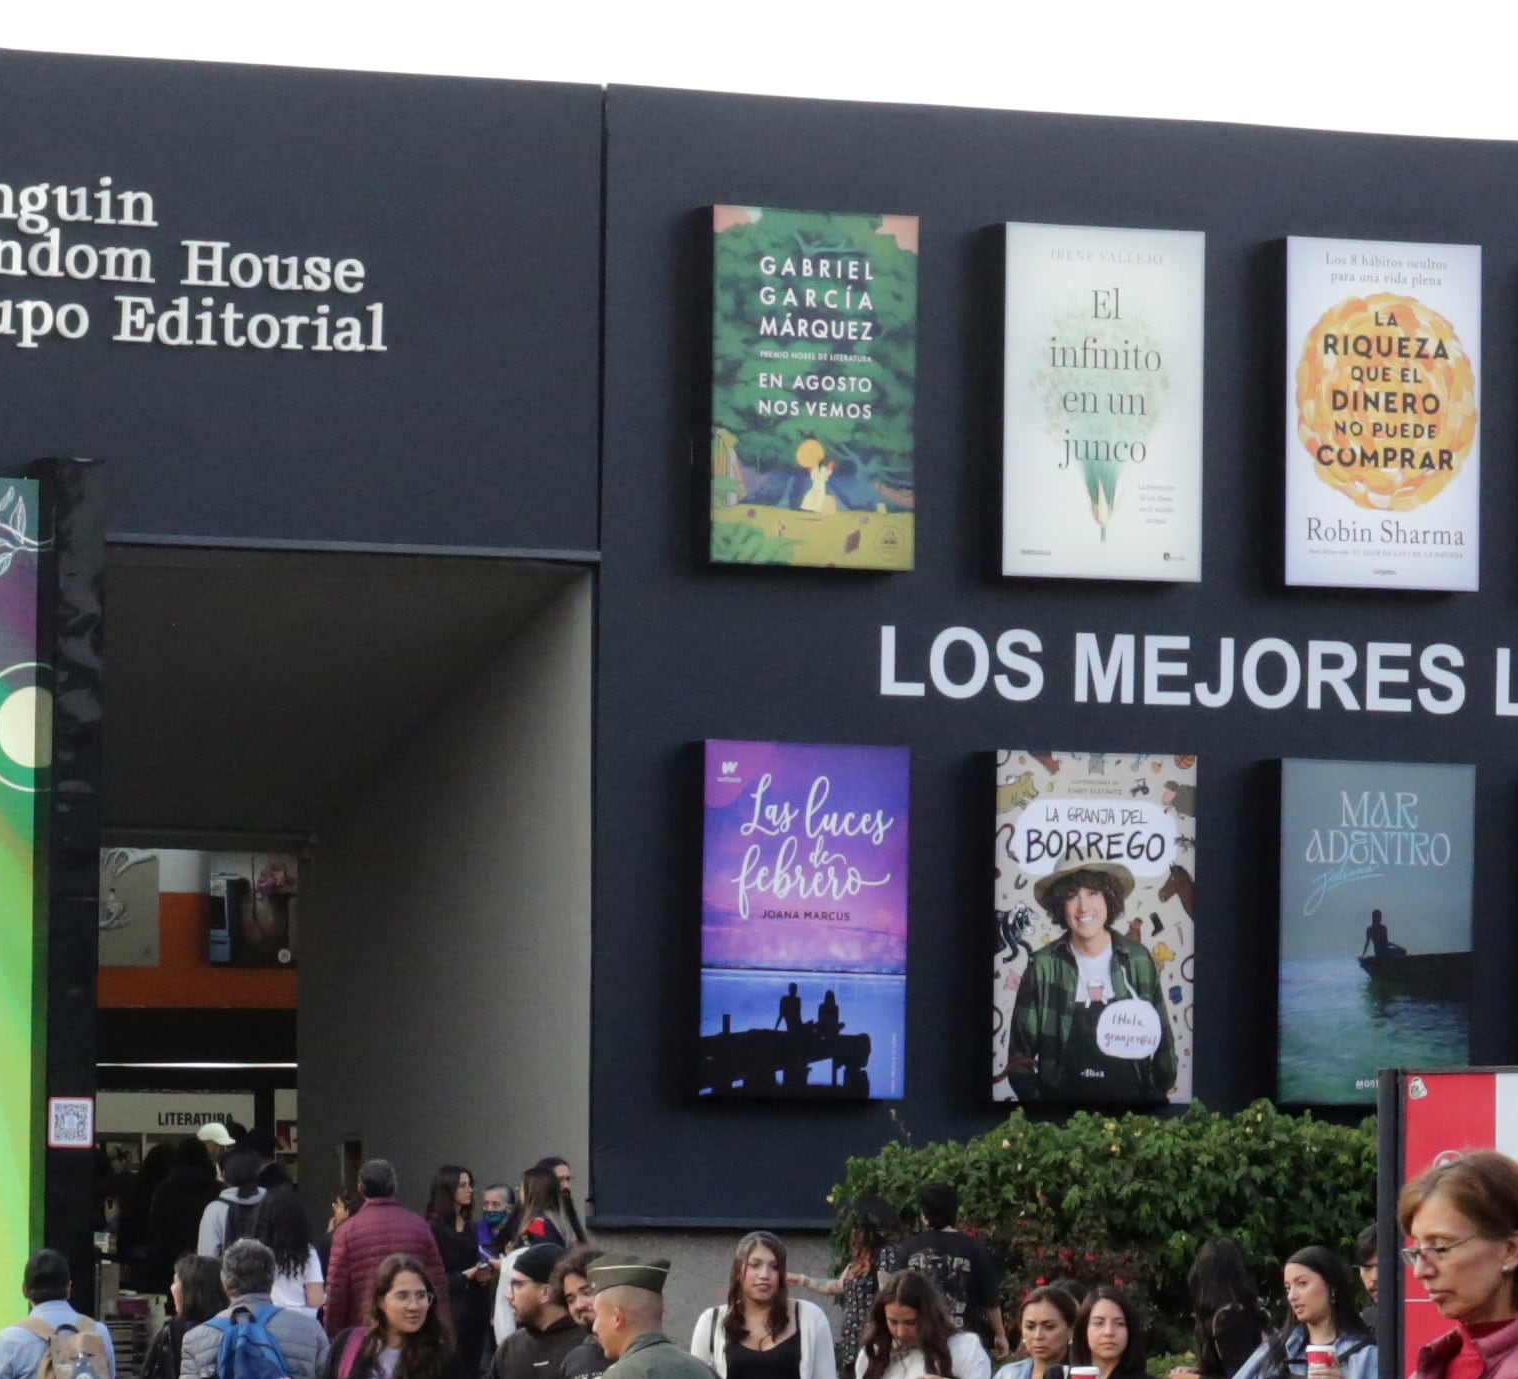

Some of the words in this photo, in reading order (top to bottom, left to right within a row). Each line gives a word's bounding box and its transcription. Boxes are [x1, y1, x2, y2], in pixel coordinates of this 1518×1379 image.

[180, 240, 365, 293] House
[759, 256, 874, 281] GABRIEL
[759, 285, 873, 310] GARCÍA
[1091, 287, 1123, 320] El
[112, 295, 388, 352] Editorial
[759, 313, 873, 341] MÁRQUEZ
[1374, 311, 1398, 327] LA
[1049, 336, 1162, 372] infinito
[1323, 333, 1449, 360] RIQUEZA
[758, 372, 783, 389] EN
[792, 373, 872, 393] AGOSTO
[1351, 365, 1391, 383] QUE
[1400, 368, 1422, 384] EL
[758, 400, 799, 416] NOS
[806, 402, 872, 419] VEMOS
[1062, 388, 1098, 413] en
[1109, 391, 1147, 416] un
[1332, 389, 1441, 416] DINERO
[1334, 420, 1363, 437] NO
[1372, 422, 1438, 440] PUEDE
[1058, 430, 1147, 469] junco
[1316, 444, 1454, 471] COMPRAR
[1306, 517, 1374, 543] Robin
[1380, 519, 1465, 546] Sharma
[879, 624, 1045, 702] LOS
[1074, 631, 1467, 716] MEJORES
[740, 772, 801, 837] Las
[803, 775, 895, 846] luces
[1044, 805, 1060, 824] LA
[1067, 805, 1117, 825] GRANJA
[1120, 807, 1149, 825] DEL
[1340, 790, 1419, 831] MAR
[808, 834, 847, 870] de
[1024, 828, 1167, 865] BORREGO
[1305, 829, 1452, 867] ADENTRO
[730, 835, 892, 921] febrero
[157, 1112, 234, 1127] LITERATURA
